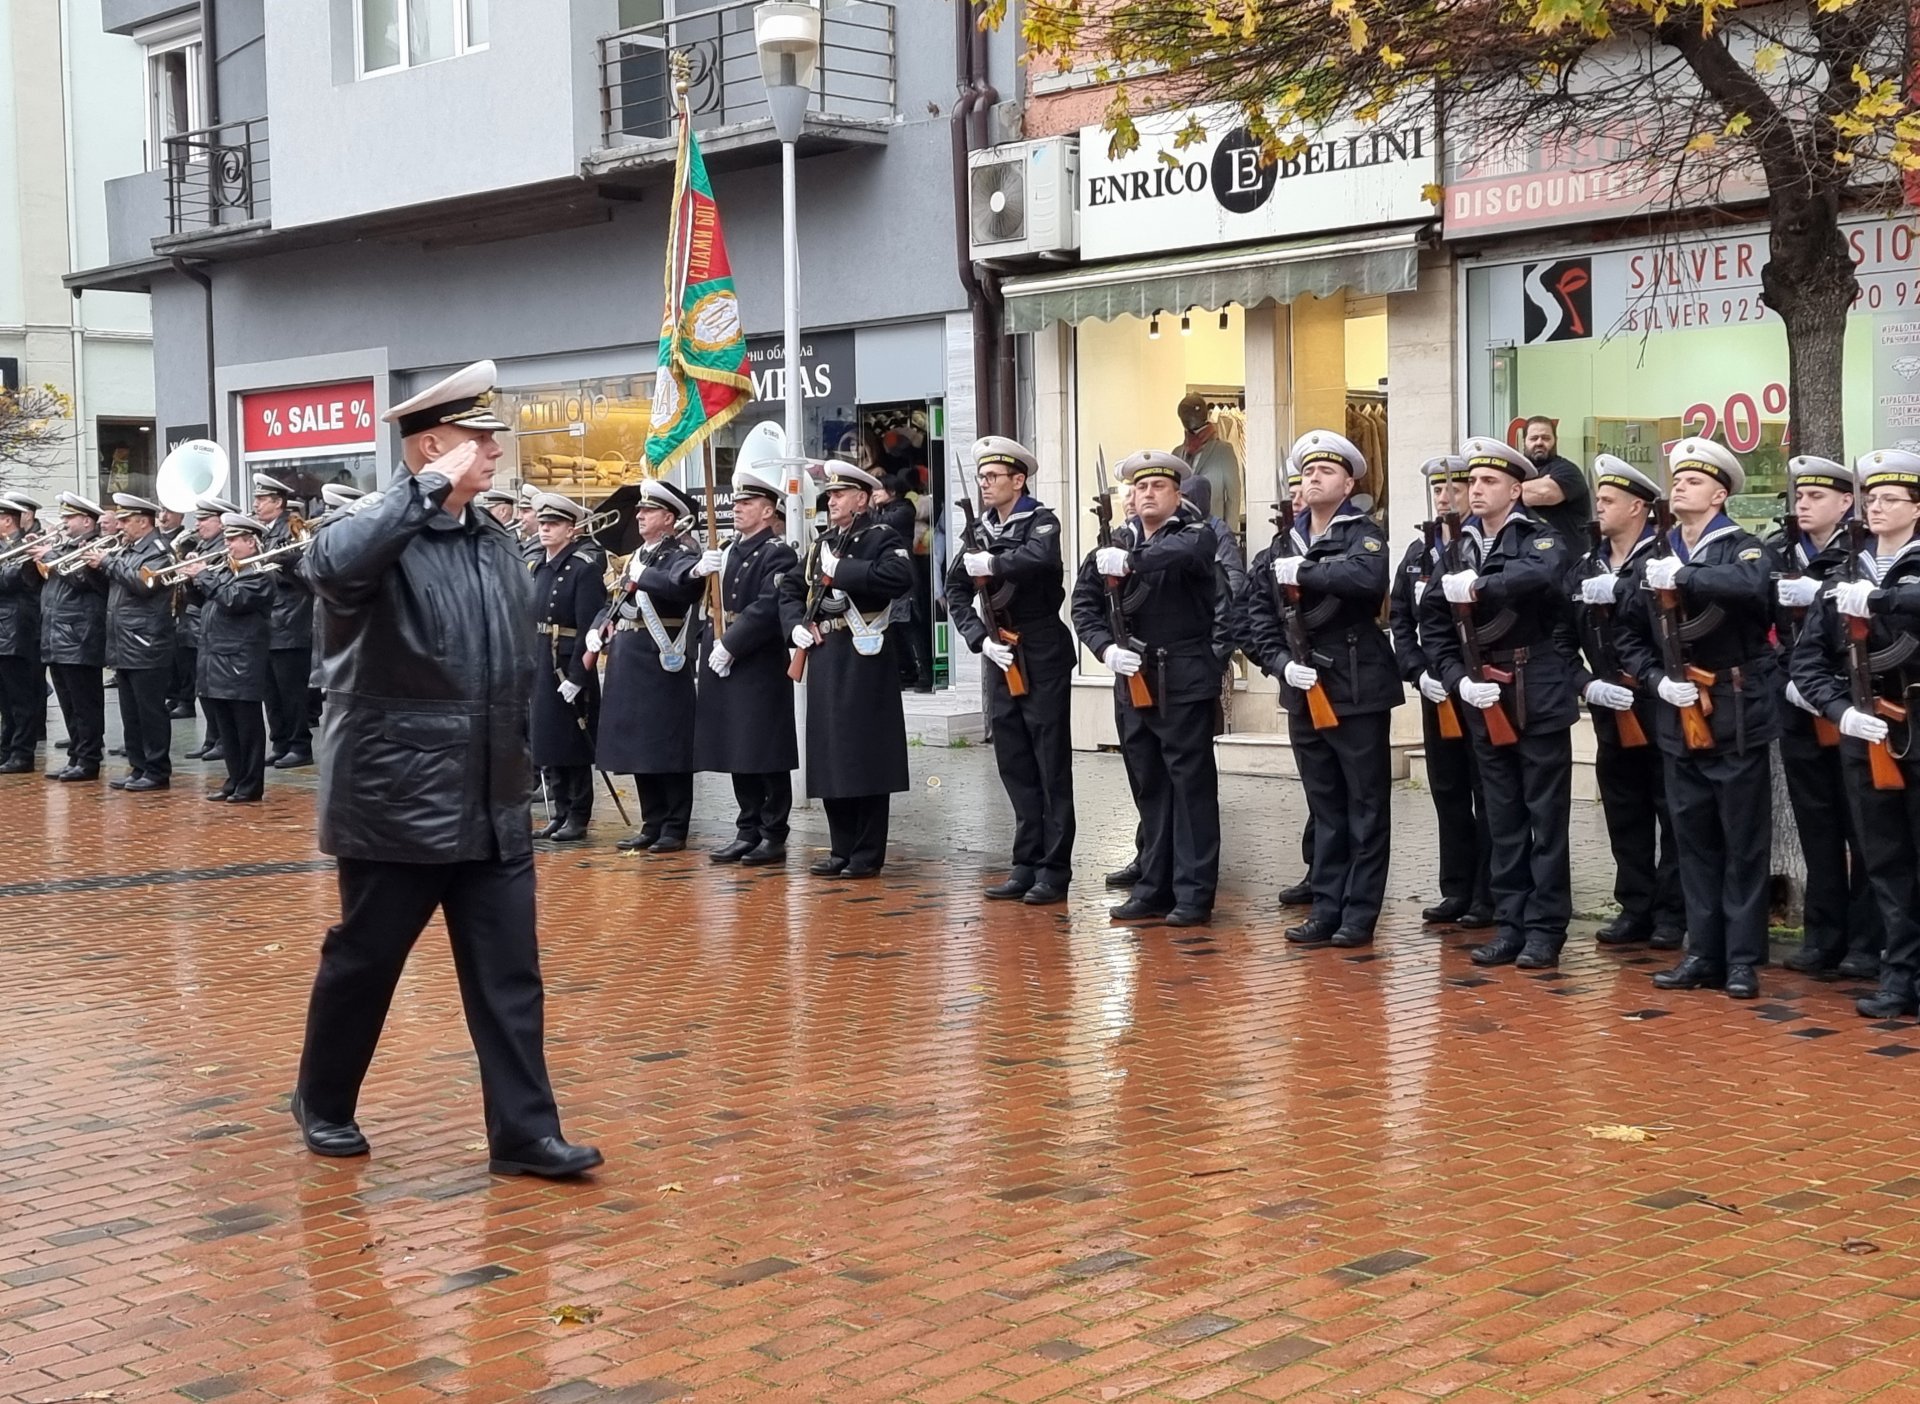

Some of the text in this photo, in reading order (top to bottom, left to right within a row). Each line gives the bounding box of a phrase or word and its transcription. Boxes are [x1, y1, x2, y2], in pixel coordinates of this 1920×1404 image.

[1088, 161, 1208, 207] ENRICO
[1279, 126, 1425, 180] BELLINI
[1630, 223, 1913, 290] SILVER SIO
[1629, 298, 1765, 332] SILVER 925
[288, 401, 344, 433] SALE
